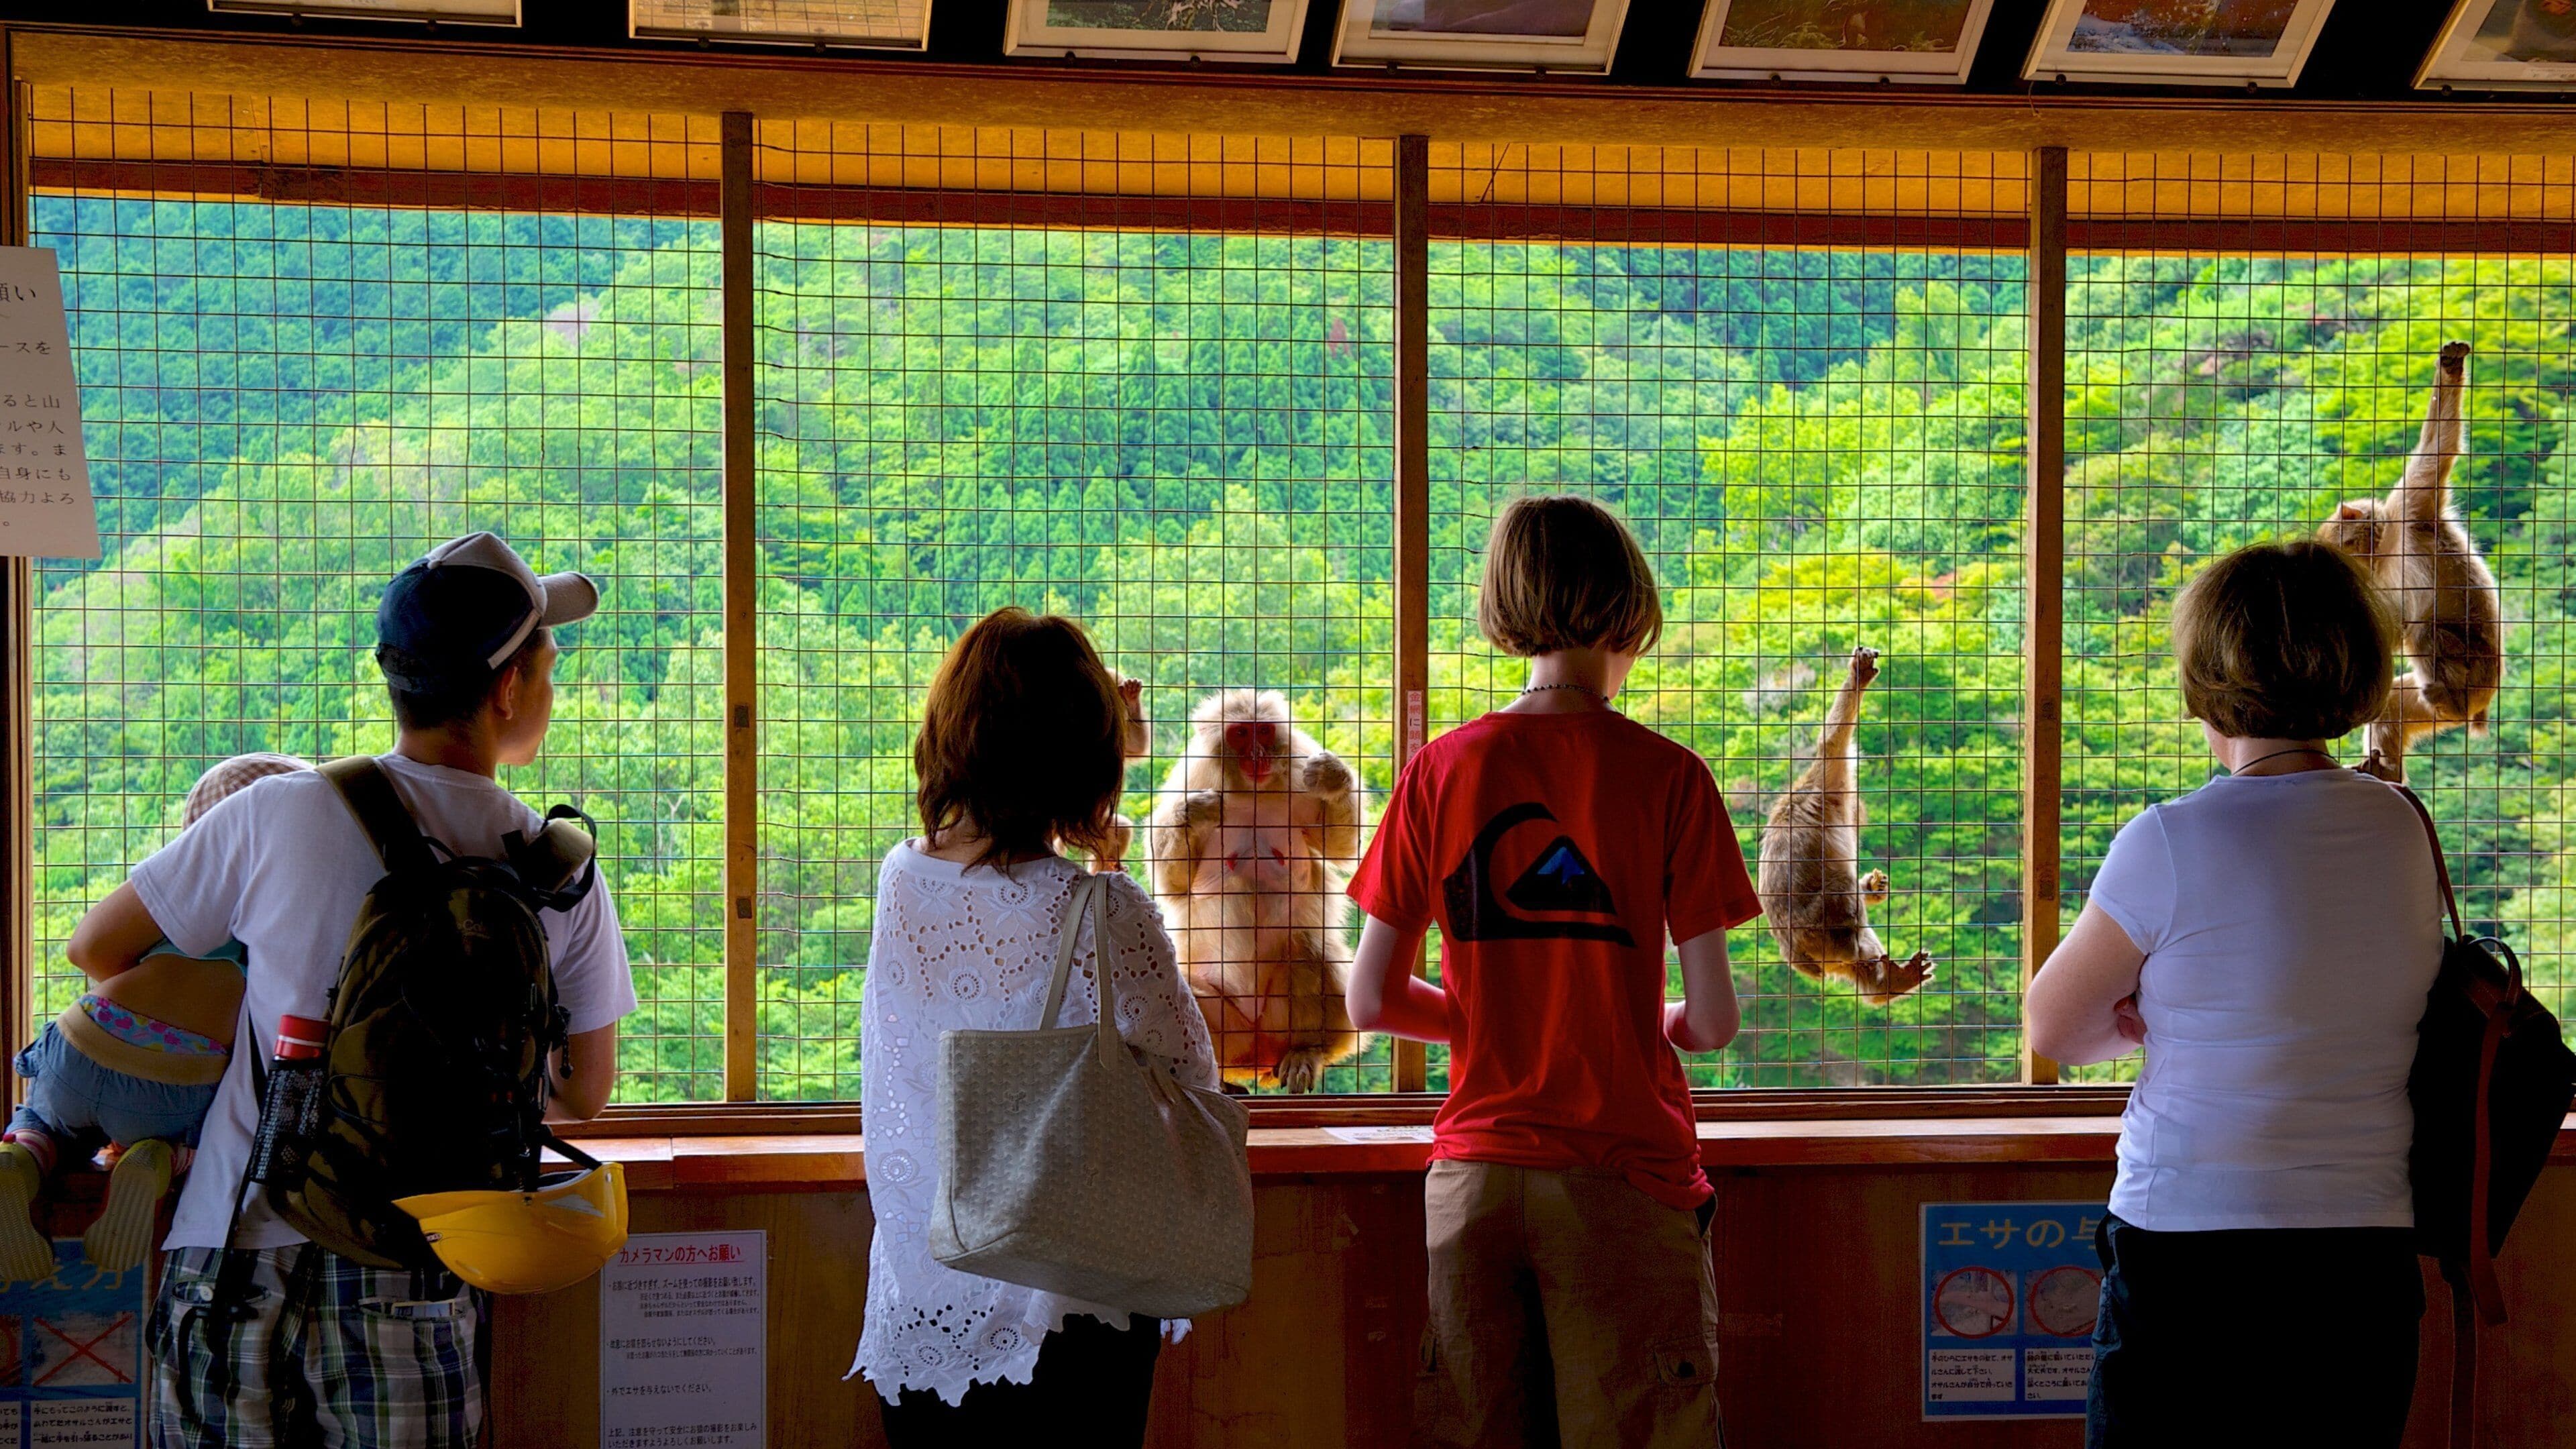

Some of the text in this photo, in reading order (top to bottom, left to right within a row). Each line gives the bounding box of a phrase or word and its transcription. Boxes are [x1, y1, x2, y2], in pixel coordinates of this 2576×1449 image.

[3, 393, 61, 409] ると山
[0, 420, 66, 435] ルや人
[1409, 692, 1421, 759] 金網に頭を
[620, 1244, 741, 1263] カメラマンの方へお願い
